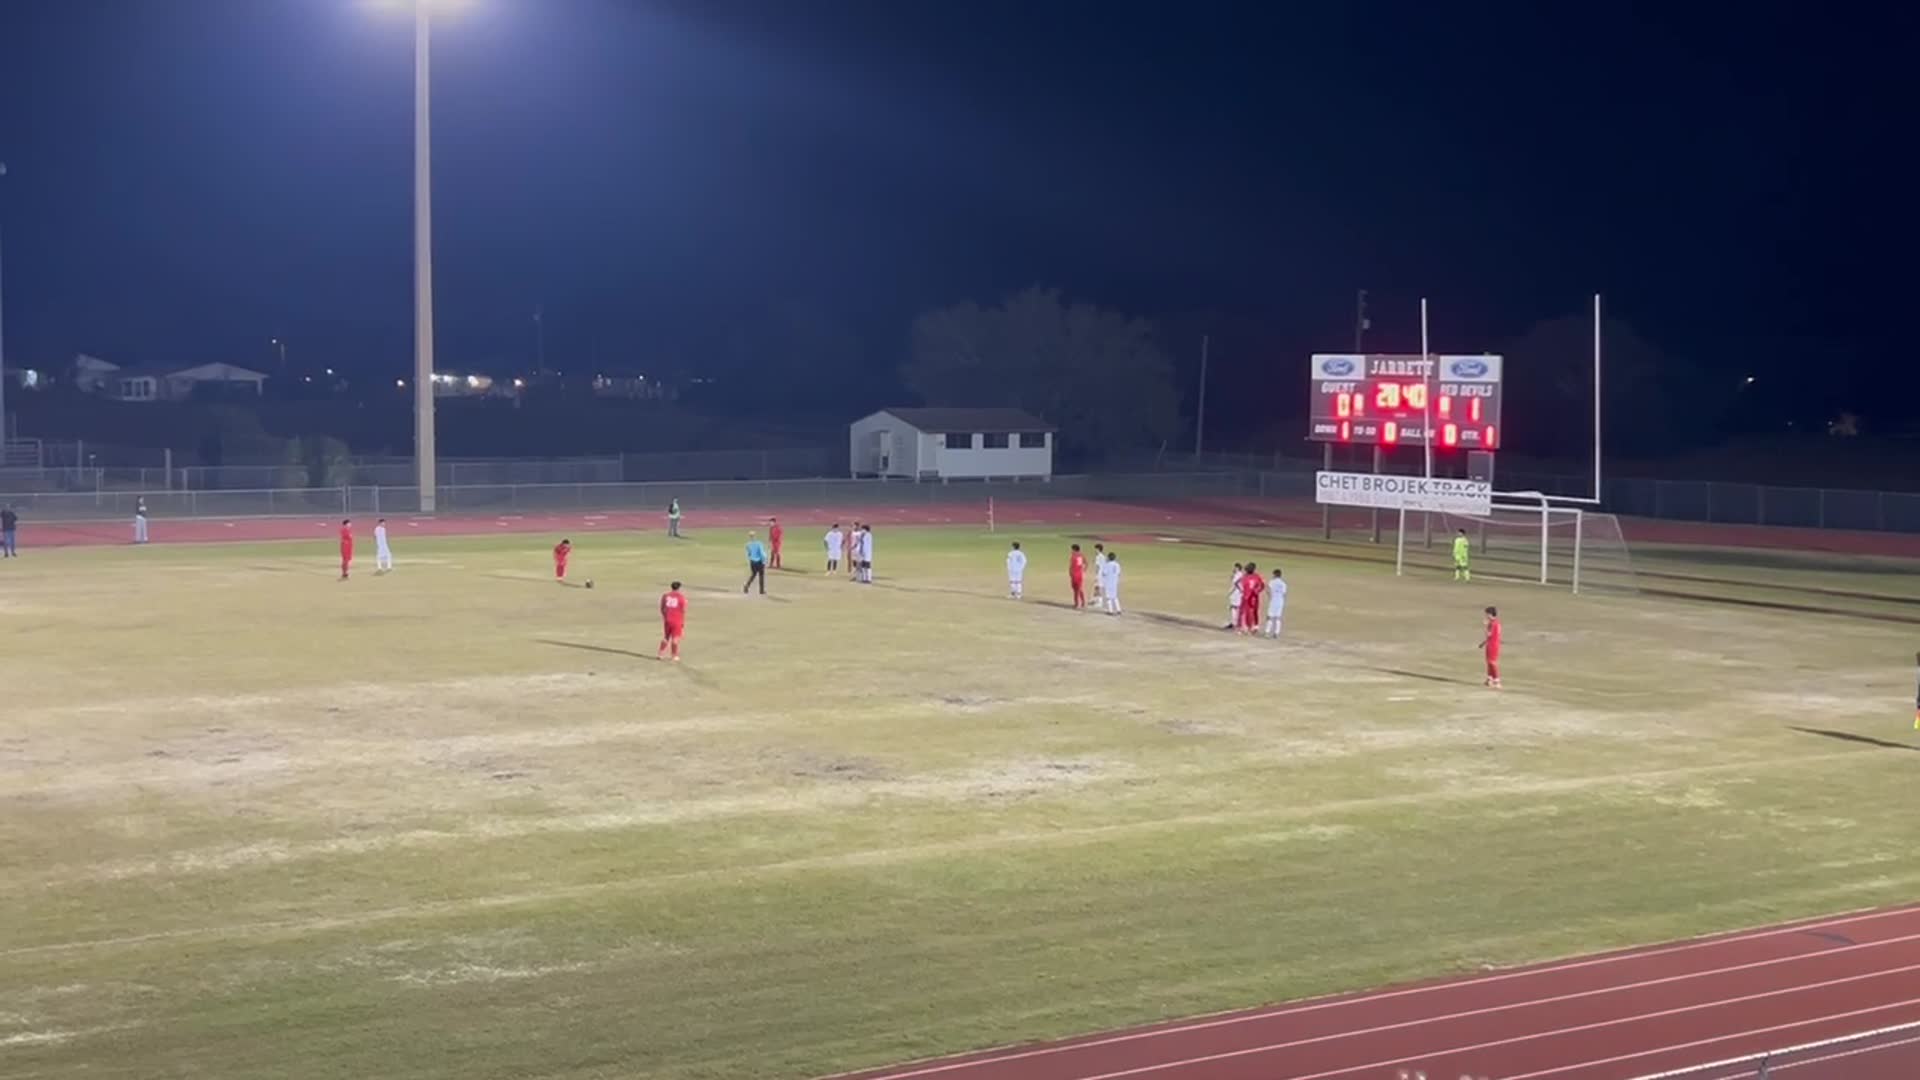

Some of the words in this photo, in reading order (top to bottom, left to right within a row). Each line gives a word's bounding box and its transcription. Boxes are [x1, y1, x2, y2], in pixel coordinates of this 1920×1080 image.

[1370, 360, 1435, 376] JARRETT
[1321, 382, 1356, 394] GUEST
[1440, 384, 1458, 396] RED
[1460, 385, 1493, 397] DEVILS
[1472, 397, 1480, 421] 1
[1314, 424, 1337, 434] DOWN
[1342, 421, 1349, 440] 1
[1400, 428, 1422, 438] BALL
[1319, 474, 1358, 490] CHET
[1362, 477, 1428, 494] BROJEK
[1432, 481, 1488, 499] TRACK
